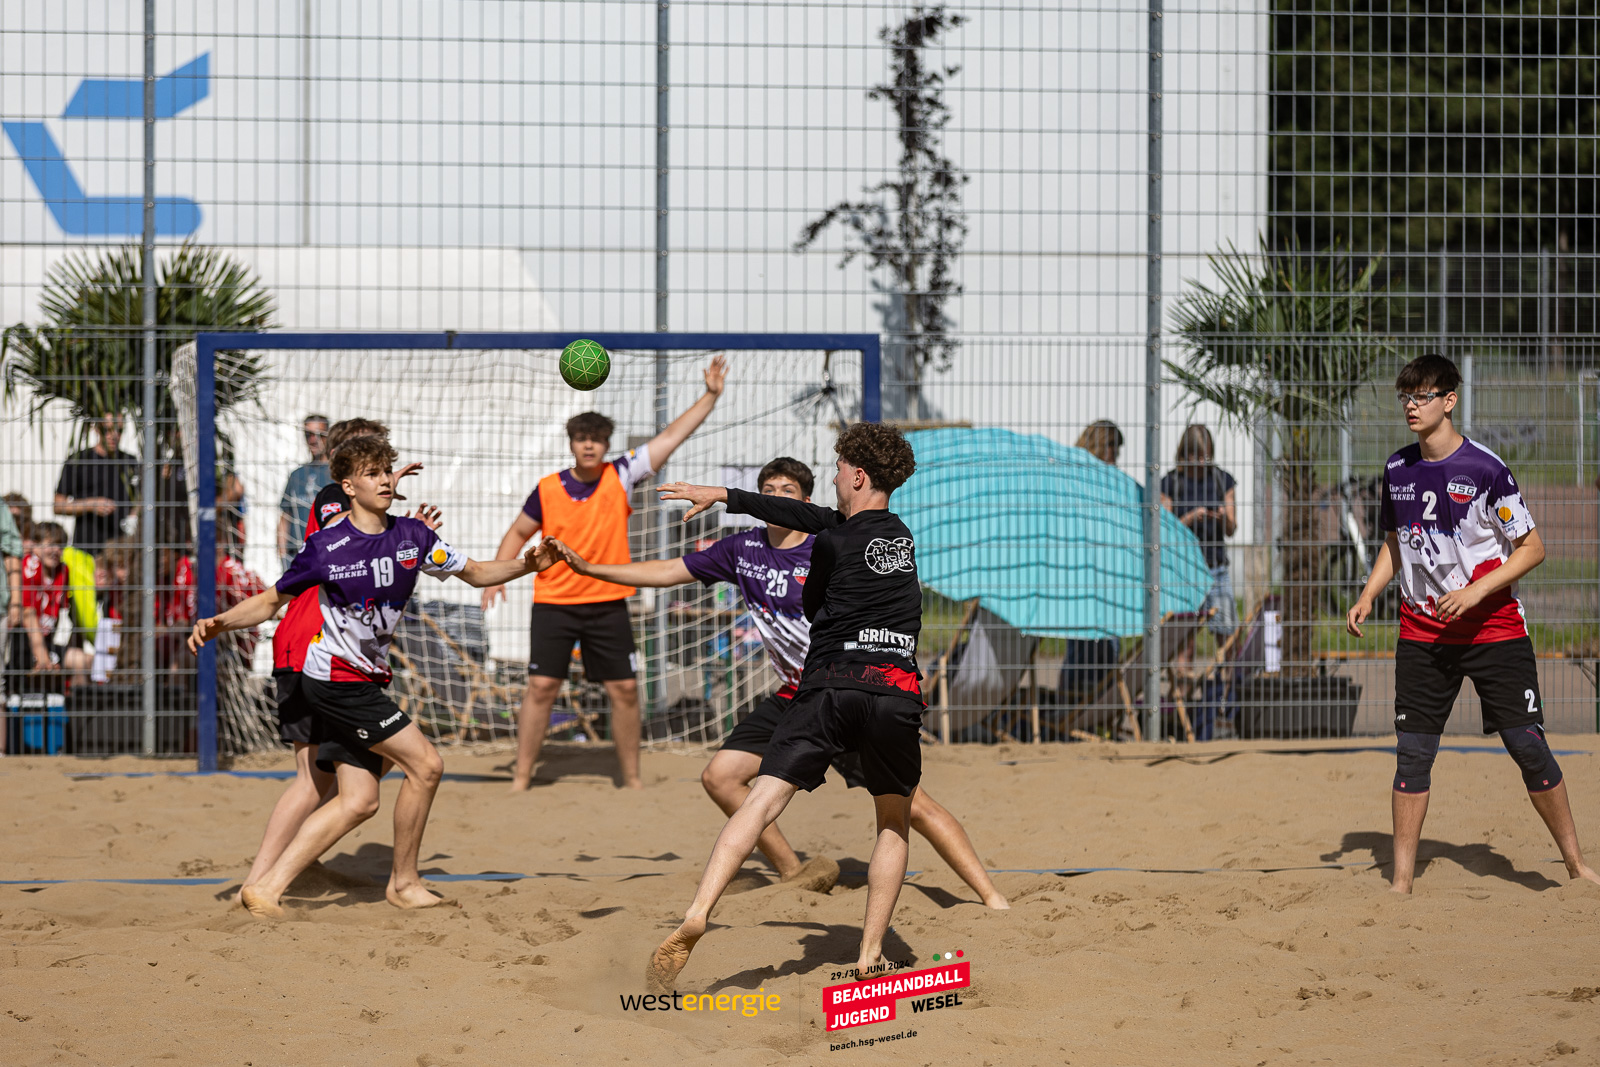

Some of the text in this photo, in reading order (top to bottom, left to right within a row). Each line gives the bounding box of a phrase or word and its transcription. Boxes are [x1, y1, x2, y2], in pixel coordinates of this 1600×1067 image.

[1390, 493, 1416, 501] IRKNER
[1448, 483, 1475, 495] JSG
[1422, 490, 1437, 520] 2
[326, 536, 351, 552] Kempa
[873, 542, 911, 562] HSG
[398, 549, 419, 560] JSG
[328, 570, 368, 581] BIRKNER
[370, 556, 394, 588] 19
[765, 568, 790, 598] 25
[1524, 688, 1538, 713] 2
[379, 711, 403, 728] Kempa
